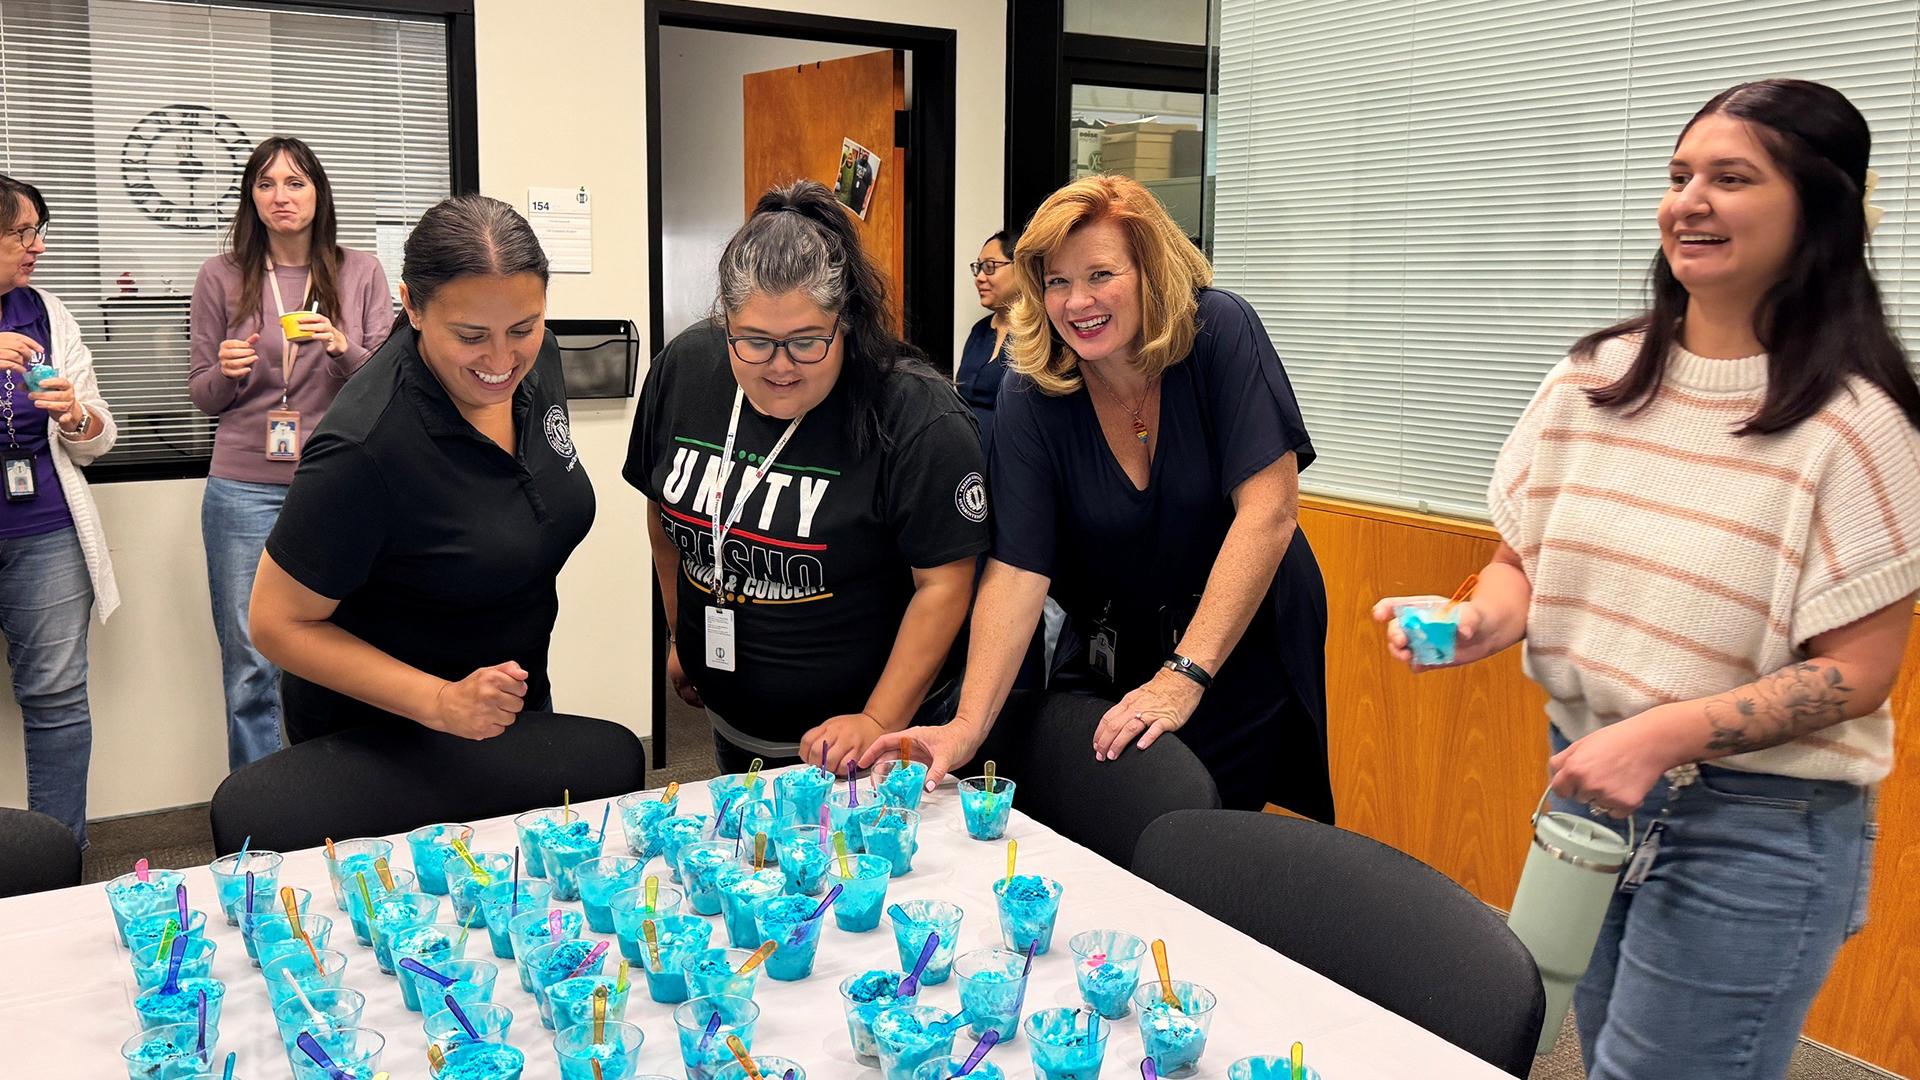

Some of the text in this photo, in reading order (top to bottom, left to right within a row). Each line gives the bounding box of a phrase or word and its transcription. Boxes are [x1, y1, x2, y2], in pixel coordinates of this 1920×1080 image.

[532, 201, 550, 211] 154
[663, 447, 830, 538] UNITY
[724, 574, 738, 593] &
